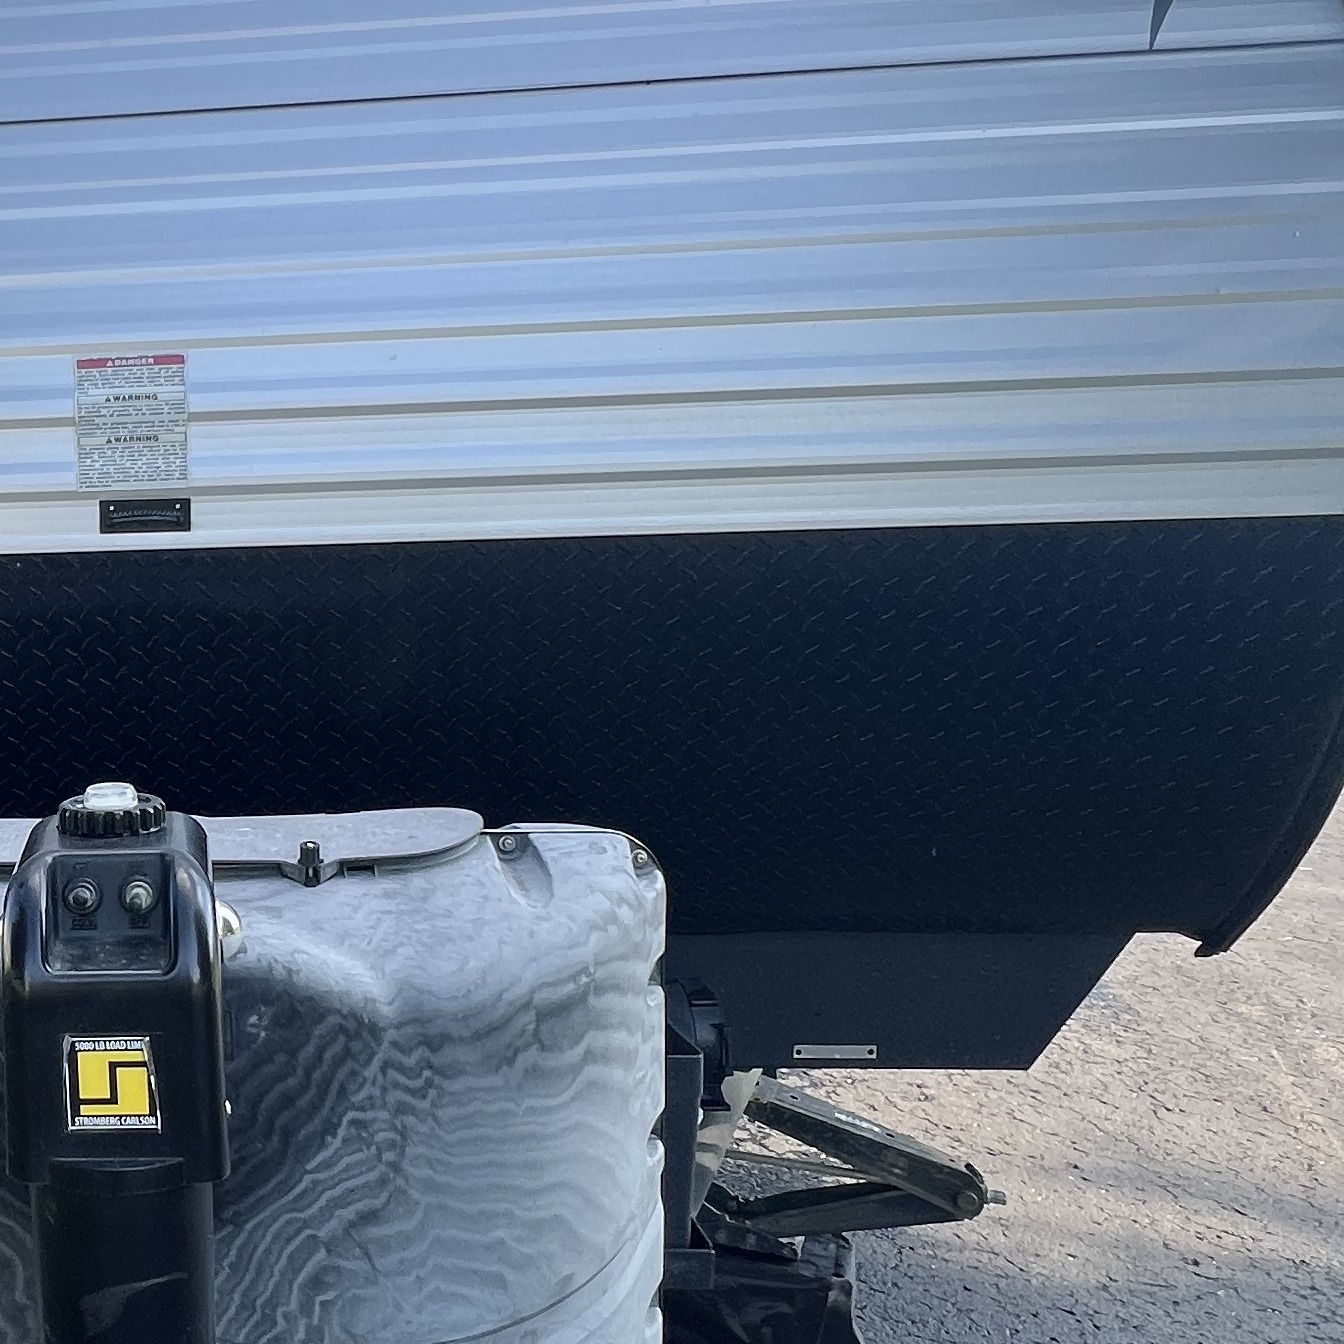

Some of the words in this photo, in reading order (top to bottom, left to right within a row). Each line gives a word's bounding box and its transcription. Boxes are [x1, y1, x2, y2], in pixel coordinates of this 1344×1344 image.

[114, 358, 155, 366] DANGER
[113, 394, 158, 403] WARNING
[113, 435, 160, 444] WARNING
[74, 1041, 94, 1051] 5000
[106, 1040, 126, 1050] LOAD
[74, 1117, 120, 1126] STROMBERG
[121, 1116, 156, 1125] CARLSON
